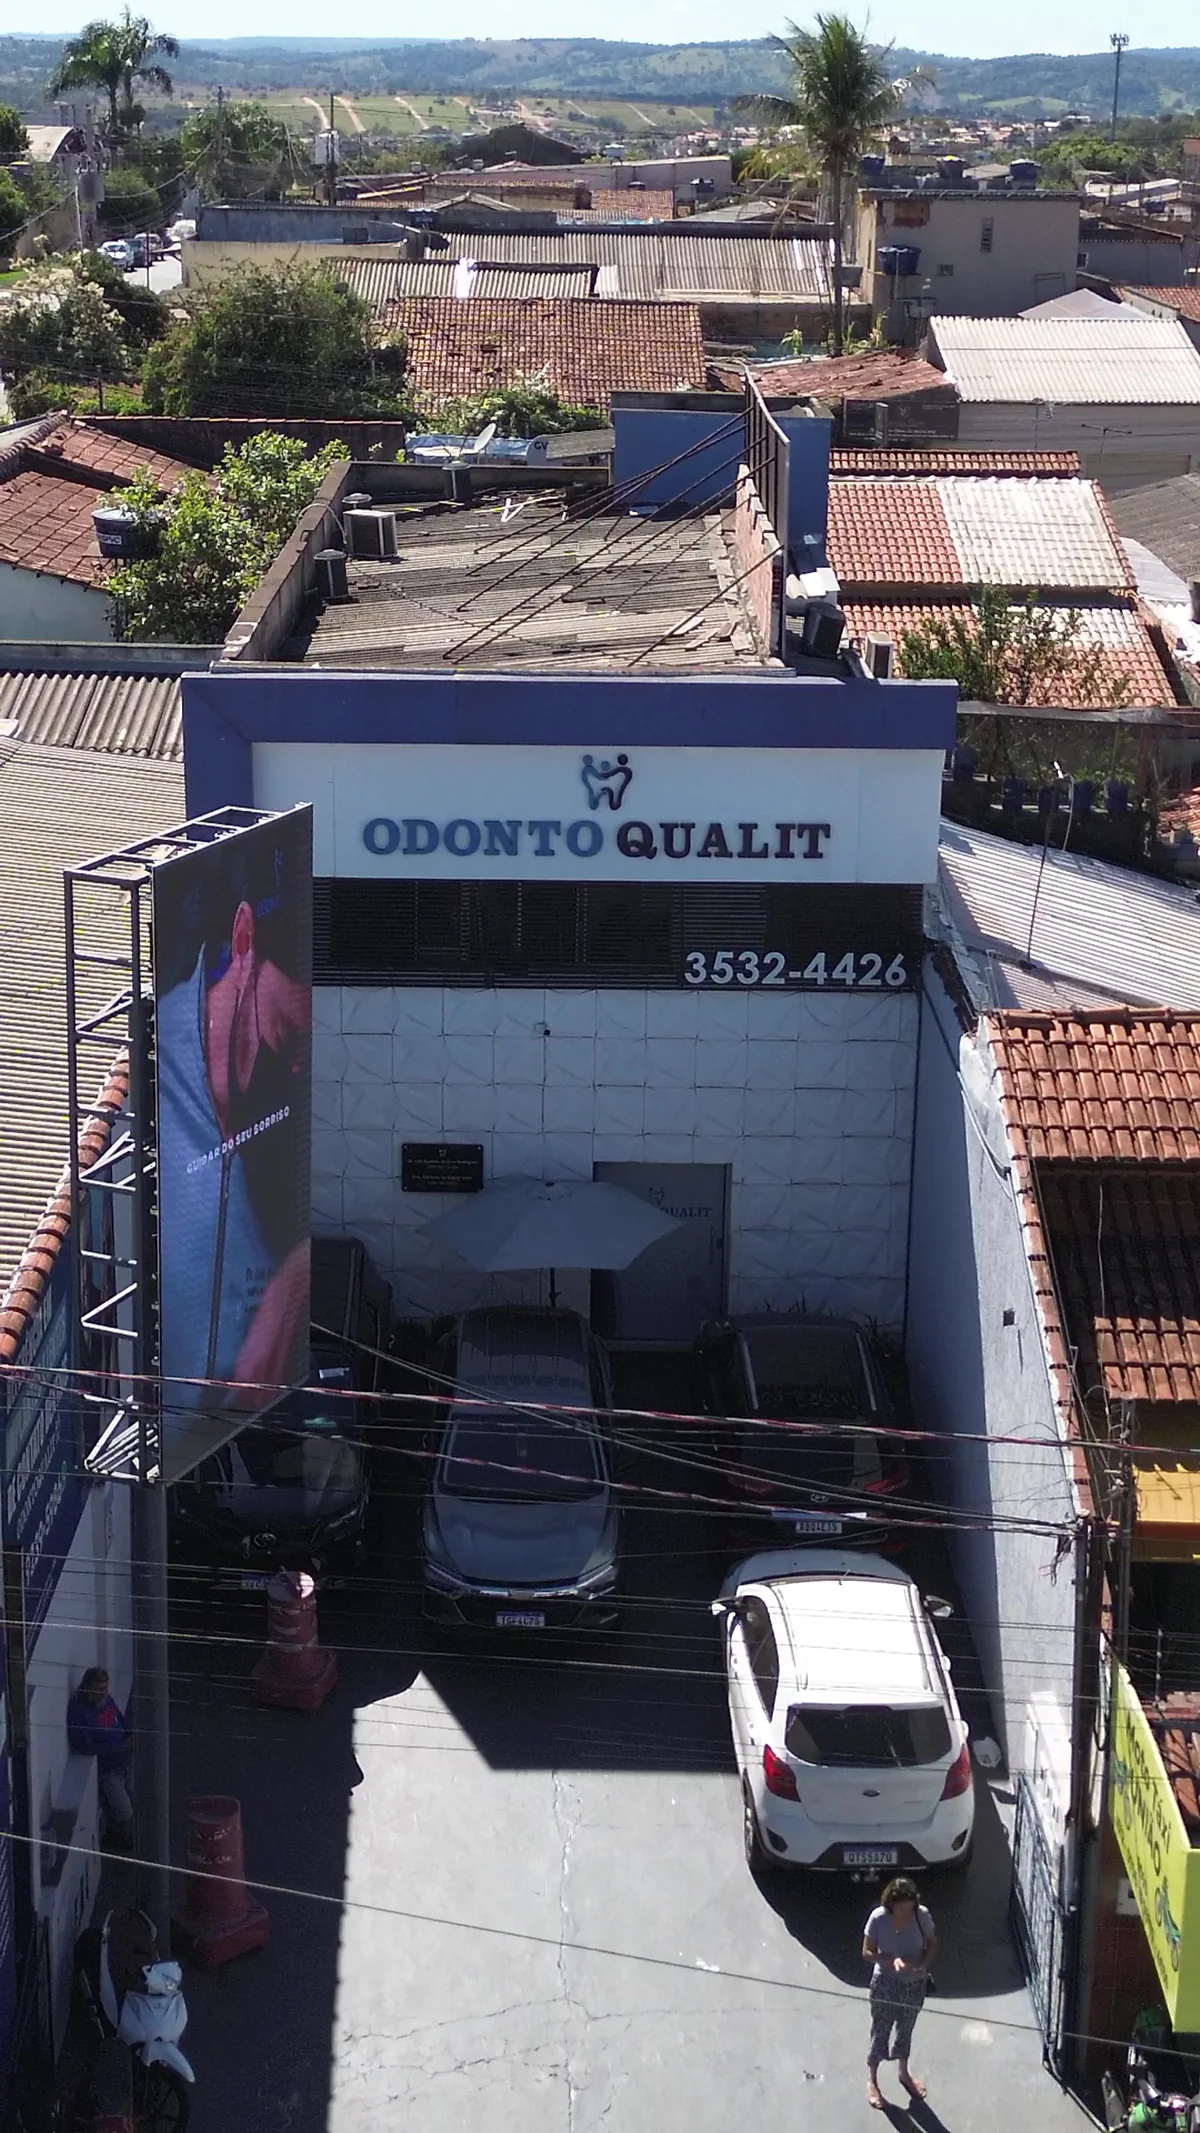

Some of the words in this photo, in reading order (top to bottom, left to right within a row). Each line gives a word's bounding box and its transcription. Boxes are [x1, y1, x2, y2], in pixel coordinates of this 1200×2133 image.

[684, 951, 907, 986] 3532-4426
[186, 1147, 220, 1174] CUIDAR
[221, 1138, 234, 1154] DO
[235, 1128, 252, 1145] SEU
[253, 1105, 290, 1136] SORRISO
